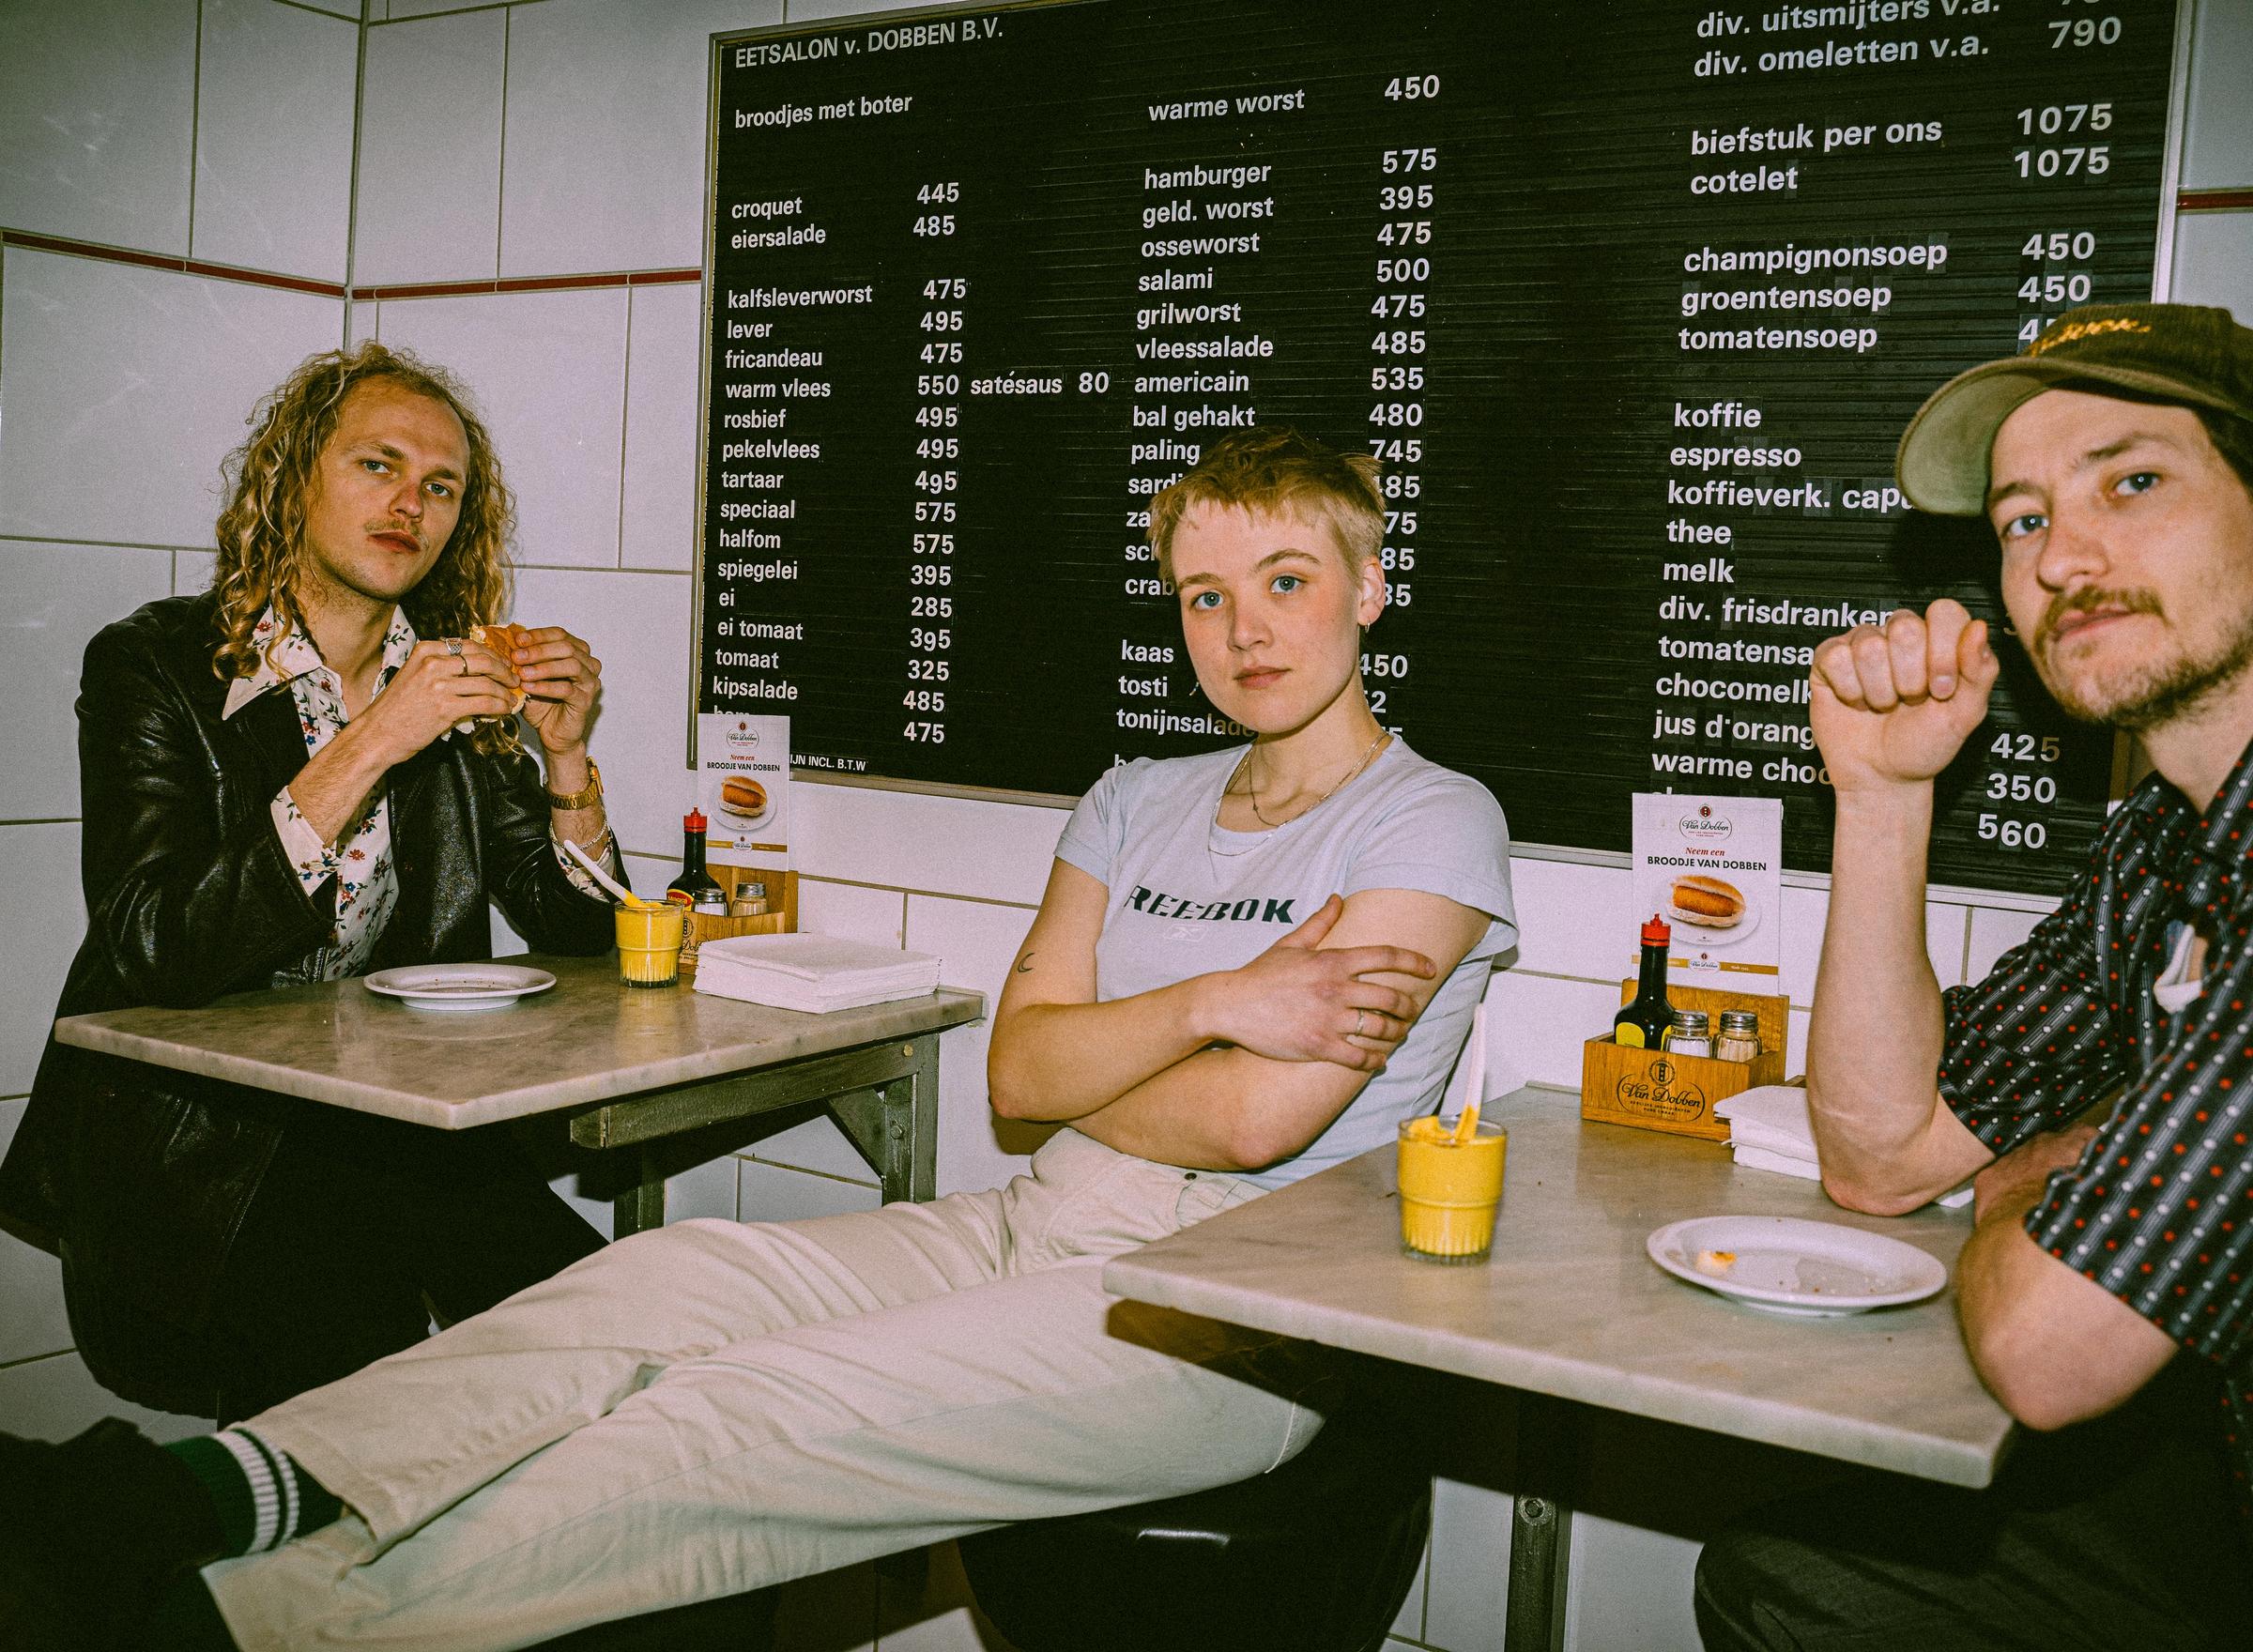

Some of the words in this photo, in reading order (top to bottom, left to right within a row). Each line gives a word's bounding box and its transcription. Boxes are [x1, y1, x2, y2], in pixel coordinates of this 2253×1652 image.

[1696, 10, 1750, 38] div.
[1762, 0, 1930, 32] uitsmijters
[1940, 0, 2000, 16] v.a.
[735, 37, 838, 69] EETSALON
[844, 39, 861, 54] v.
[867, 22, 956, 53] DOBBEN
[962, 17, 1003, 41] B.V.
[2048, 16, 2122, 49] 790
[1694, 50, 1747, 77] div.
[1758, 39, 1918, 72] omeletten
[1929, 36, 1988, 58] v.a.
[1384, 74, 1440, 101] 450
[735, 103, 813, 129] broodjes
[819, 99, 855, 120] met
[860, 95, 912, 116] boter
[1148, 99, 1229, 121] warme
[1235, 88, 1306, 114] worst
[2017, 102, 2112, 135] 1075
[1691, 123, 1815, 156] biefstuk
[1823, 125, 1878, 153] per
[1885, 121, 1942, 144] ons
[1382, 147, 1437, 174] 575
[2014, 145, 2109, 178] 1075
[1144, 164, 1272, 190] hamburger
[1690, 165, 1799, 195] cotelet
[916, 181, 959, 205] 445
[1379, 184, 1433, 210] 395
[731, 196, 803, 221] croquet
[1142, 199, 1198, 229] geld.
[1205, 196, 1274, 220] worst
[731, 222, 826, 250] eiersalade
[912, 214, 956, 237] 485
[1376, 221, 1432, 247] 475
[1141, 232, 1261, 258] osseworst
[2021, 231, 2095, 261] 450
[1376, 257, 1430, 283] 500
[1683, 243, 1948, 275] champignonsoep
[923, 278, 966, 300] 475
[1138, 267, 1213, 292] salami
[2017, 273, 2092, 303] 450
[728, 284, 873, 309] kalfsleverworst
[1371, 294, 1426, 319] 475
[1681, 285, 1892, 317] groentensoep
[920, 310, 963, 332] 495
[1136, 302, 1242, 330] grilworst
[727, 319, 774, 339] lever
[1678, 326, 1878, 354] tomatensoep
[920, 343, 963, 364] 475
[1135, 334, 1274, 359] vleessalade
[1371, 330, 1426, 355] 485
[725, 347, 822, 369] fricandeau
[725, 383, 776, 399] warm
[781, 377, 831, 398] vlees
[917, 374, 959, 396] 550
[970, 370, 1063, 395] satésaus
[1078, 372, 1110, 393] 80
[1134, 370, 1249, 393] americain
[1371, 367, 1424, 390] 535
[724, 408, 787, 429] rosbief
[915, 406, 958, 428] 495
[1132, 405, 1167, 427] bal
[1173, 404, 1256, 432] gehakt
[1369, 403, 1423, 427] 480
[1674, 402, 1762, 428] koffie
[722, 438, 820, 463] pekelvlees
[915, 437, 958, 459] 495
[1130, 438, 1201, 467] paling
[1369, 439, 1422, 464] 745
[1670, 445, 1802, 471] espresso
[721, 470, 785, 489] tartaar
[914, 470, 958, 495] 495
[1667, 479, 1831, 509] koffieverk.
[720, 498, 796, 522] speciaal
[914, 501, 957, 523] 575
[1126, 512, 1152, 528] za
[1383, 511, 1418, 535] 75
[1665, 518, 1732, 544] thee
[719, 528, 781, 549] halfom
[912, 533, 955, 555] 575
[717, 558, 798, 583] spiegelei
[1380, 546, 1415, 571] 85
[1663, 558, 1735, 583] melk
[911, 564, 952, 587] 395
[718, 588, 735, 607] ei
[911, 596, 953, 619] 285
[1659, 595, 1711, 621] div.
[717, 621, 733, 636] ei
[739, 620, 804, 640] tomaat
[910, 627, 951, 652] 395
[714, 648, 779, 669] tomaat
[1121, 638, 1174, 664] kaas
[1658, 635, 1815, 666] tomatensa
[908, 659, 950, 681] 325
[1359, 652, 1408, 678] 450
[713, 675, 798, 700] kipsalade
[1117, 675, 1168, 697] tosti
[1655, 672, 1812, 704] chocomelk
[902, 690, 945, 712] 485
[903, 721, 945, 744] 475
[1652, 709, 1696, 740] jus
[1705, 713, 1816, 751] d'orang
[1990, 732, 2061, 762] 425
[707, 761, 736, 770] BROODJE
[752, 763, 780, 772] DOBBEN
[789, 754, 806, 765] IJN
[808, 755, 835, 769] INCL.
[836, 758, 866, 772] B.T.W
[1651, 753, 1753, 779] warme
[1986, 772, 2057, 803] 350
[1681, 819, 1699, 830] Van
[1700, 820, 1729, 832] Dobben
[1977, 813, 2046, 849] 560
[1648, 856, 1695, 867] BROODJE
[1696, 859, 1720, 868] VAN
[1723, 860, 1767, 871] DOBBEN
[1686, 847, 1709, 856] Neem
[1124, 884, 1296, 925] REEBOK
[1621, 1082, 1649, 1100] Van
[1652, 1087, 1701, 1108] Dobben
